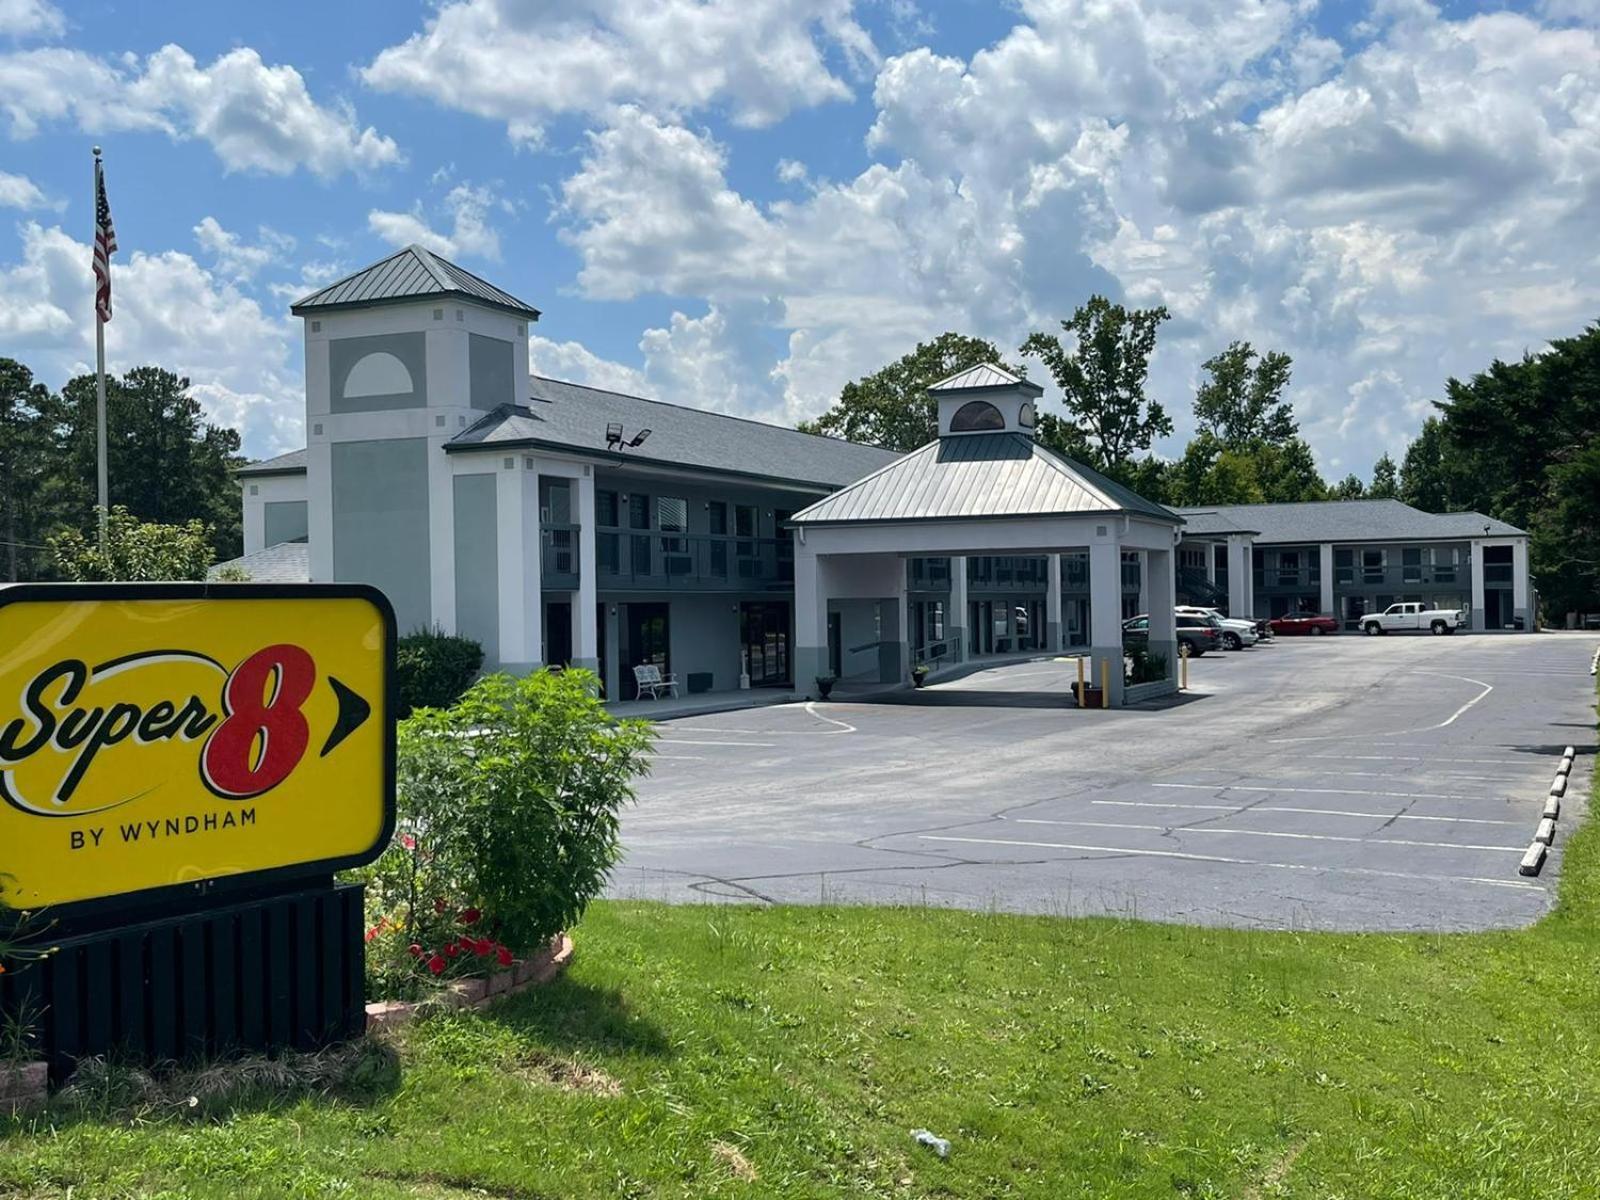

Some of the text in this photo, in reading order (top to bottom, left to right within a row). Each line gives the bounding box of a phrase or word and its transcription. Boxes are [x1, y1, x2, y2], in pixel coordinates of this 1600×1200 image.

[0, 644, 316, 804] Super 8
[71, 808, 256, 850] BY WYNDHAM
